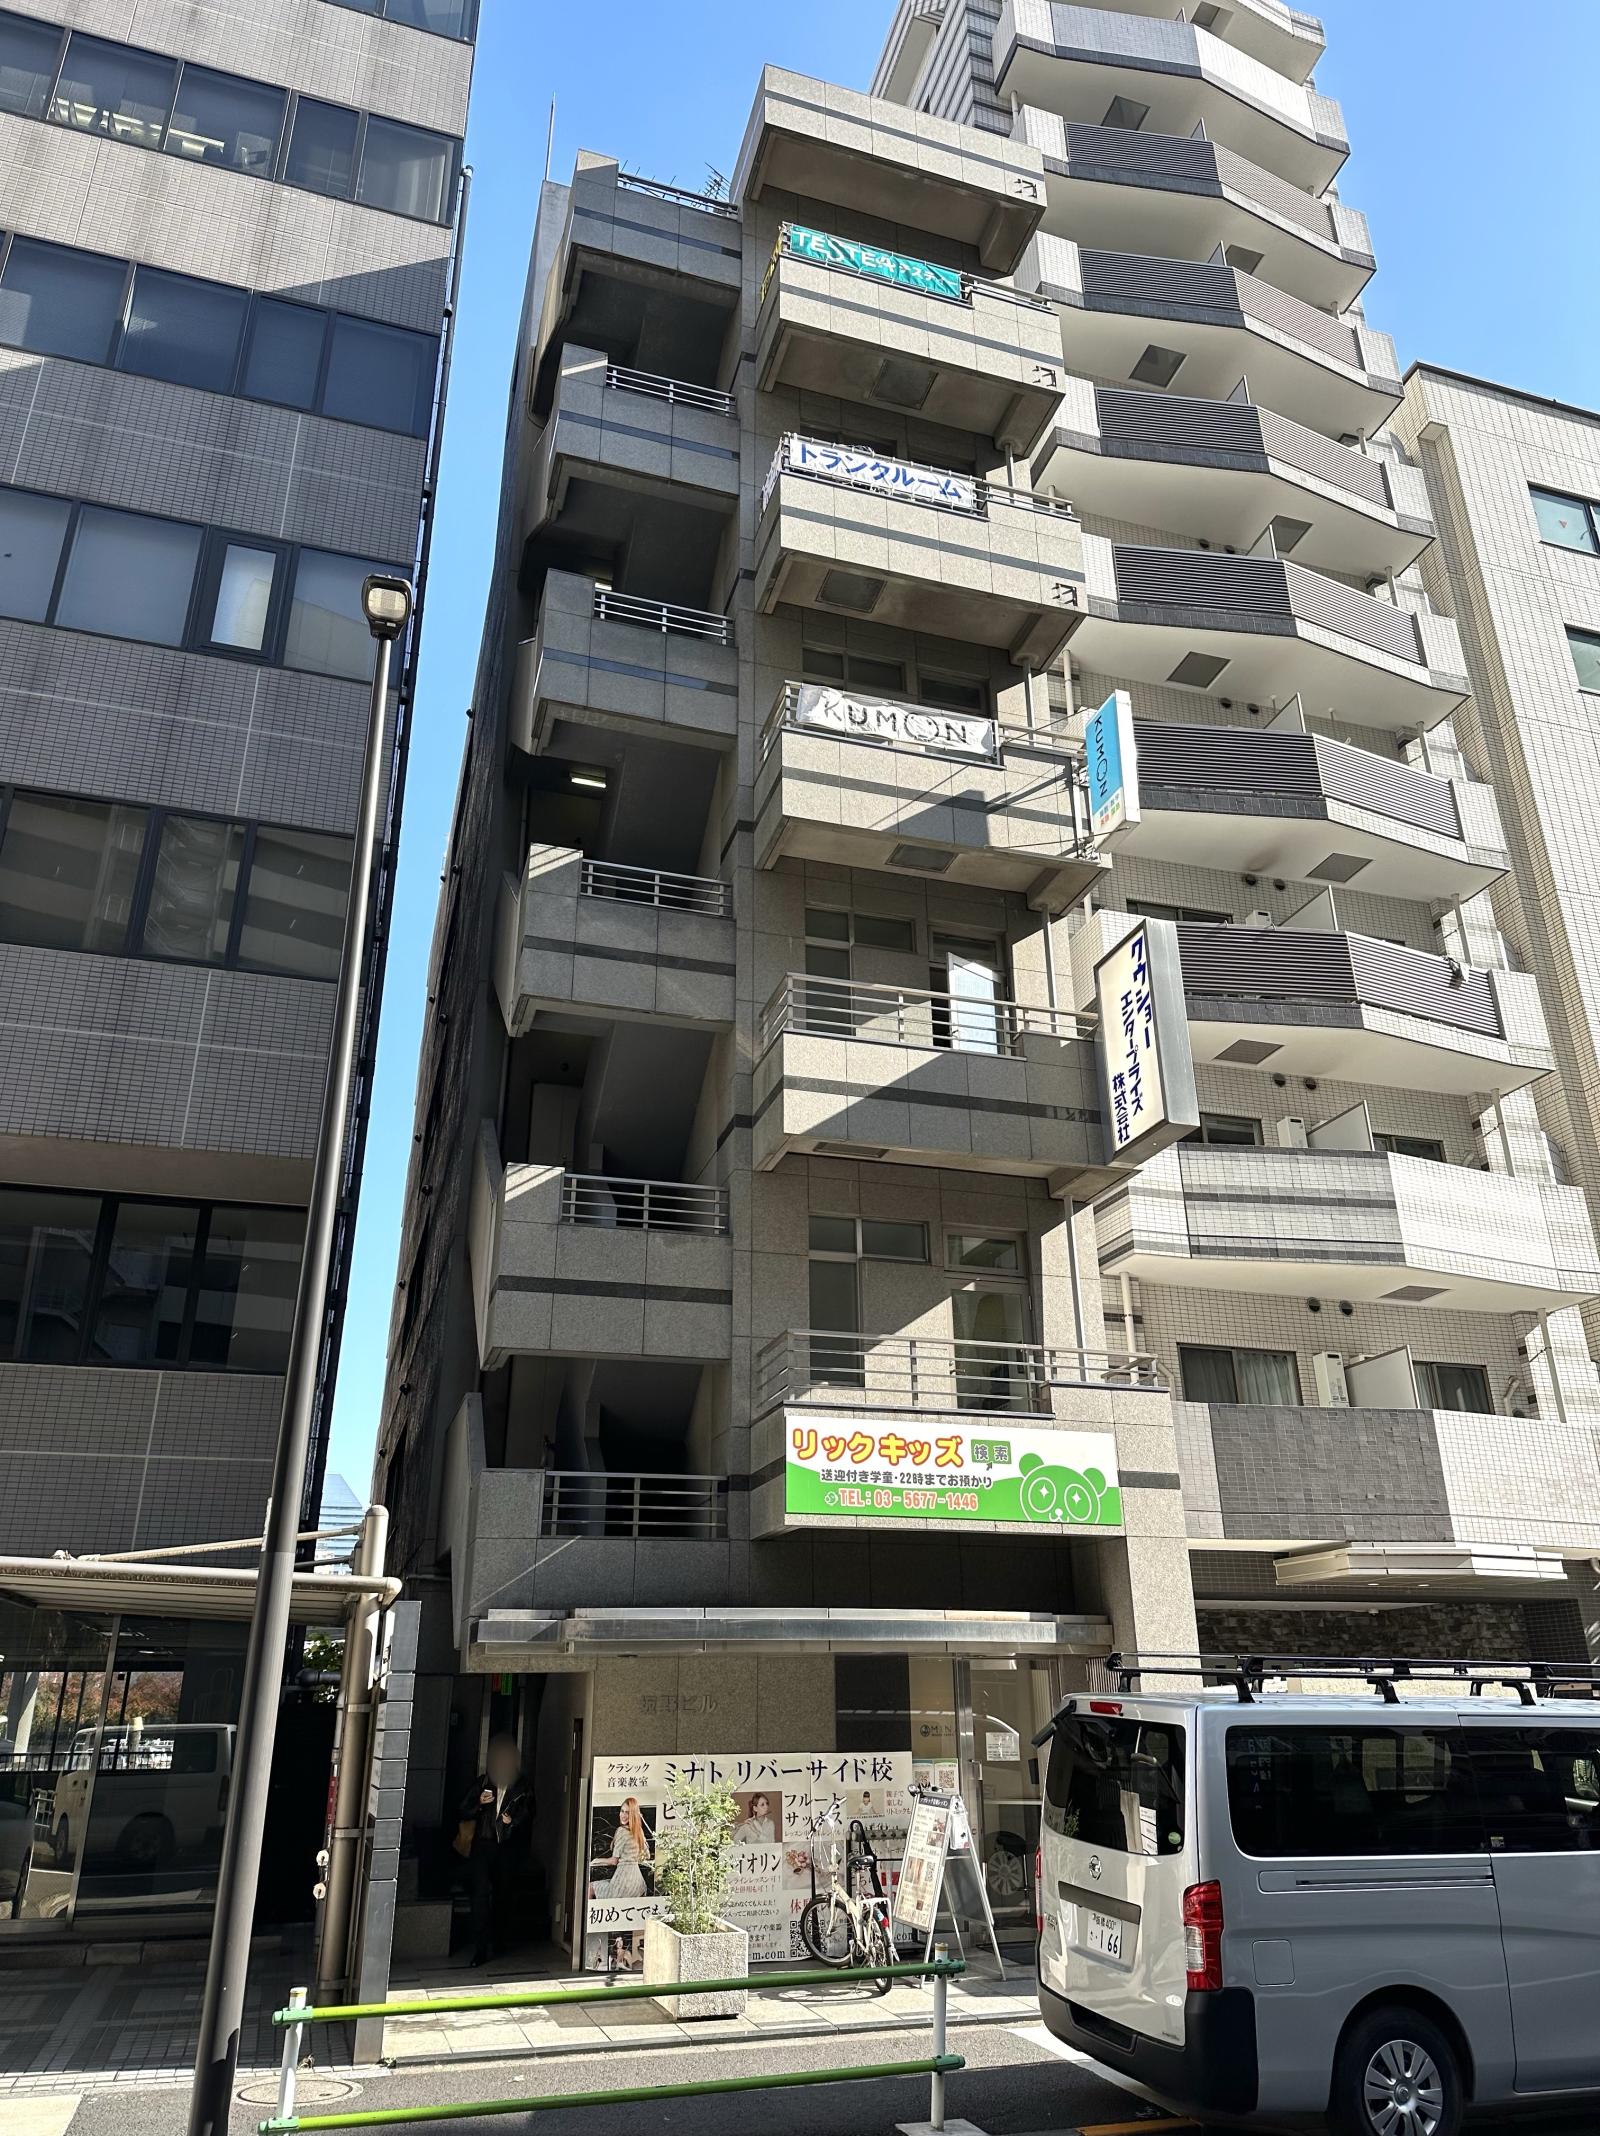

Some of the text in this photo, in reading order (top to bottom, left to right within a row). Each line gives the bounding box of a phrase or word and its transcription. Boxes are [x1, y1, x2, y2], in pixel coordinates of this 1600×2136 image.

[801, 443, 962, 499] トランクルーム
[823, 700, 967, 744] KUMON
[1095, 715, 1108, 797] KUMON
[1131, 935, 1153, 1049] クウショー
[1121, 990, 1143, 1116] エンタープライズ
[1112, 1072, 1130, 1143] 株式会社
[792, 1428, 1011, 1468] リックキッズ 検索
[820, 1468, 993, 1489] 送迎付き学童・22時までお預かり
[607, 1762, 650, 1774] クラシック
[607, 1776, 649, 1788] 音楽教室
